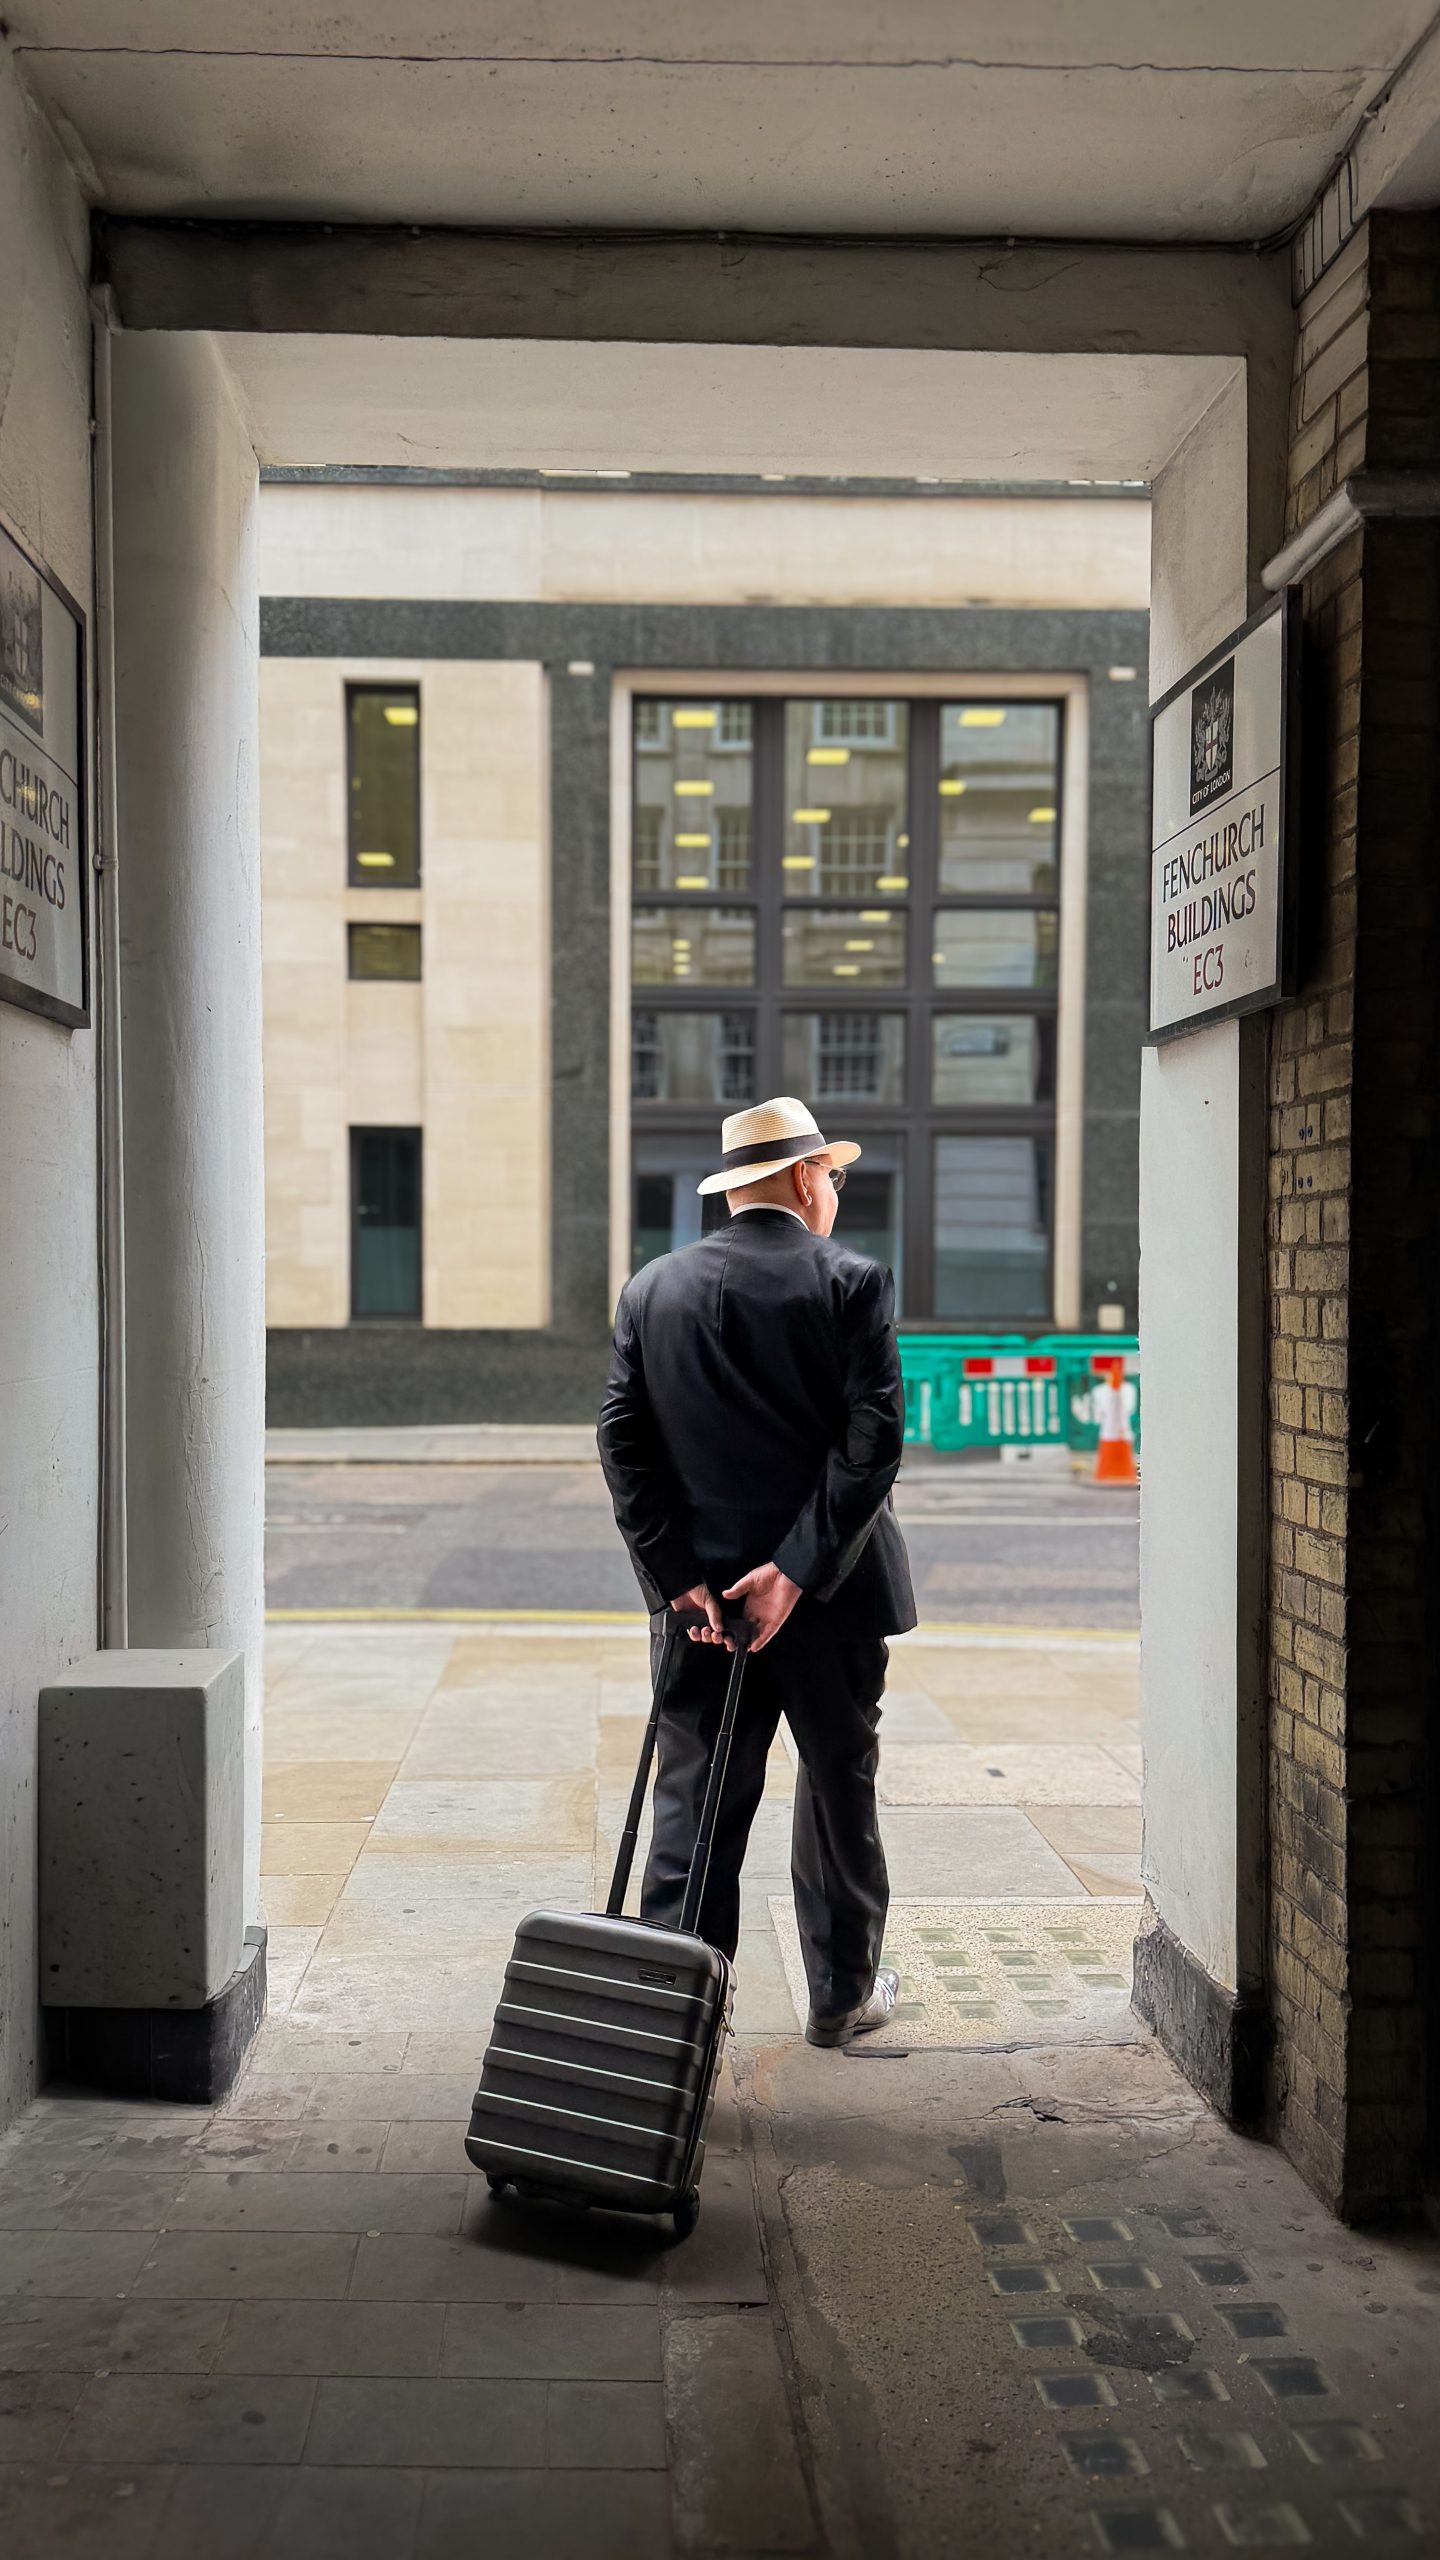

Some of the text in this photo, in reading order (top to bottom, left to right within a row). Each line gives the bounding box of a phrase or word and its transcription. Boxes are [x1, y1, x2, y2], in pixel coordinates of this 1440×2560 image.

[1192, 788, 1203, 805] CITY
[1210, 769, 1231, 793] LONDON
[1163, 804, 1265, 904] FENCHURCH
[2, 894, 37, 961] EC3
[1168, 869, 1256, 953] BUILDINGS
[1193, 944, 1224, 996] EC3
